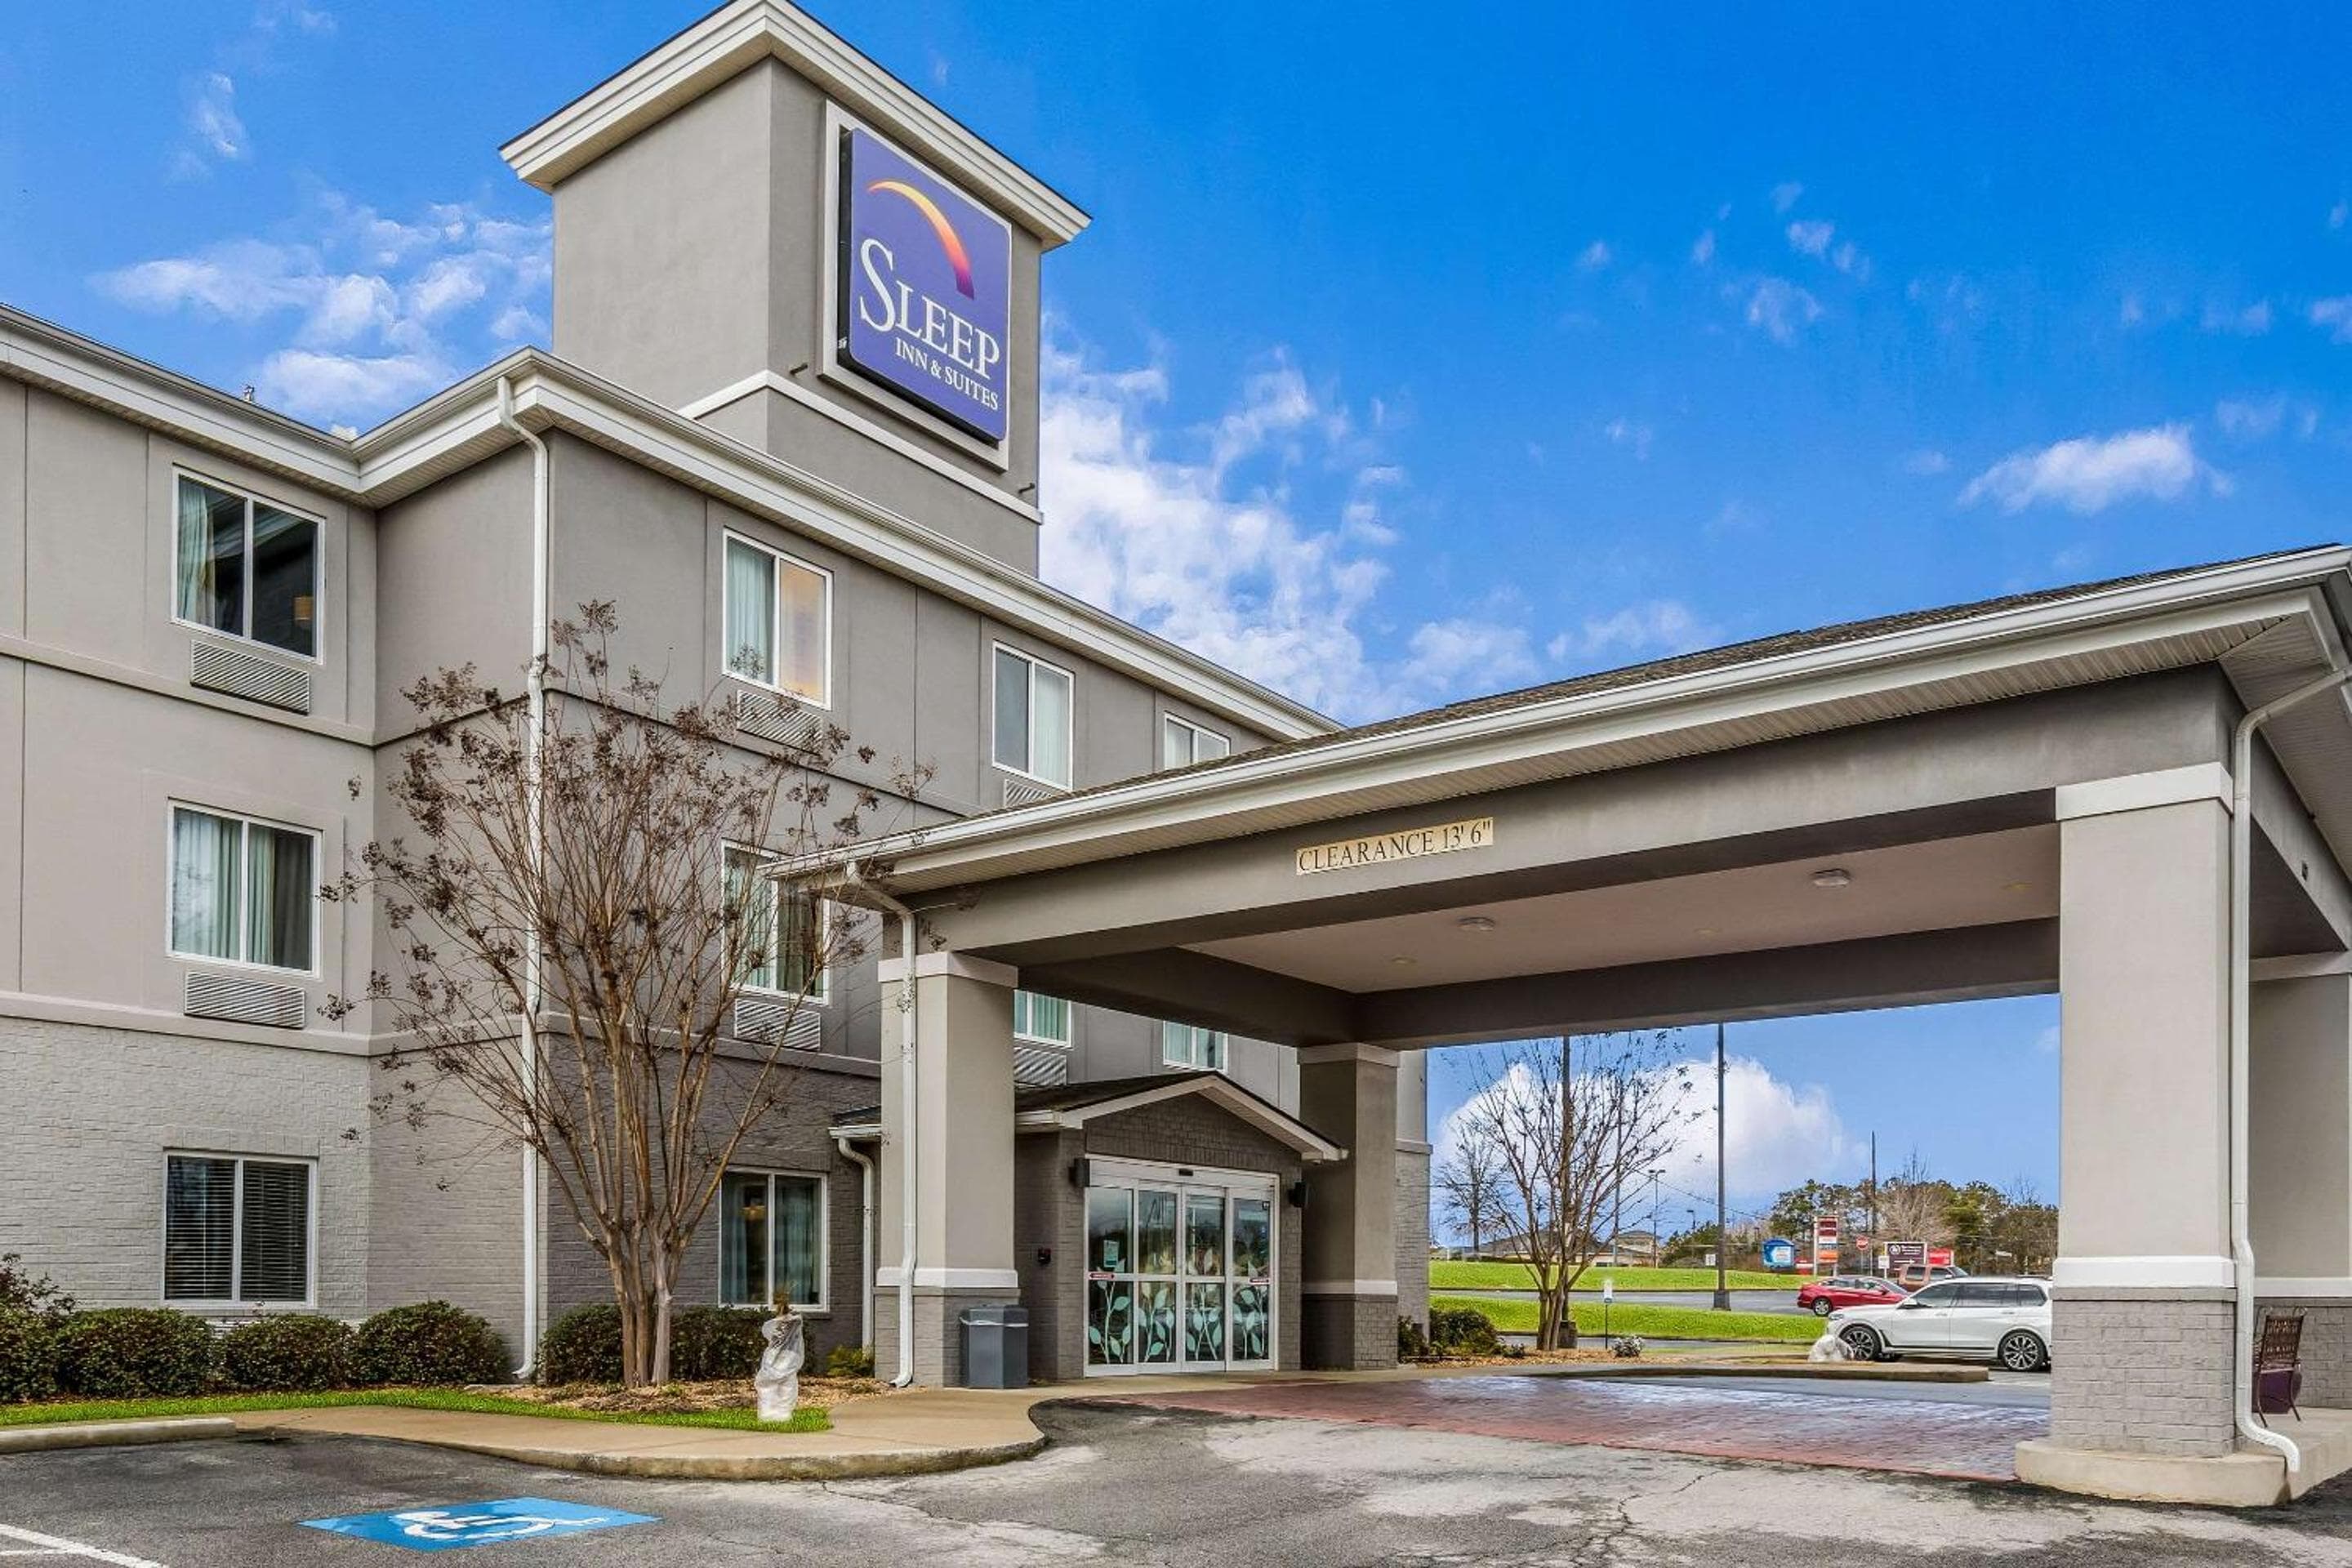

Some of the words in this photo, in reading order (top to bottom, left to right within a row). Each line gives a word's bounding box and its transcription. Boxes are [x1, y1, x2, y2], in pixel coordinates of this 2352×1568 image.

[860, 238, 1000, 380] SLEEP
[896, 336, 928, 371] INN
[931, 359, 942, 379] &
[945, 366, 999, 411] SUITES
[1298, 830, 1434, 871] CLEARANCE
